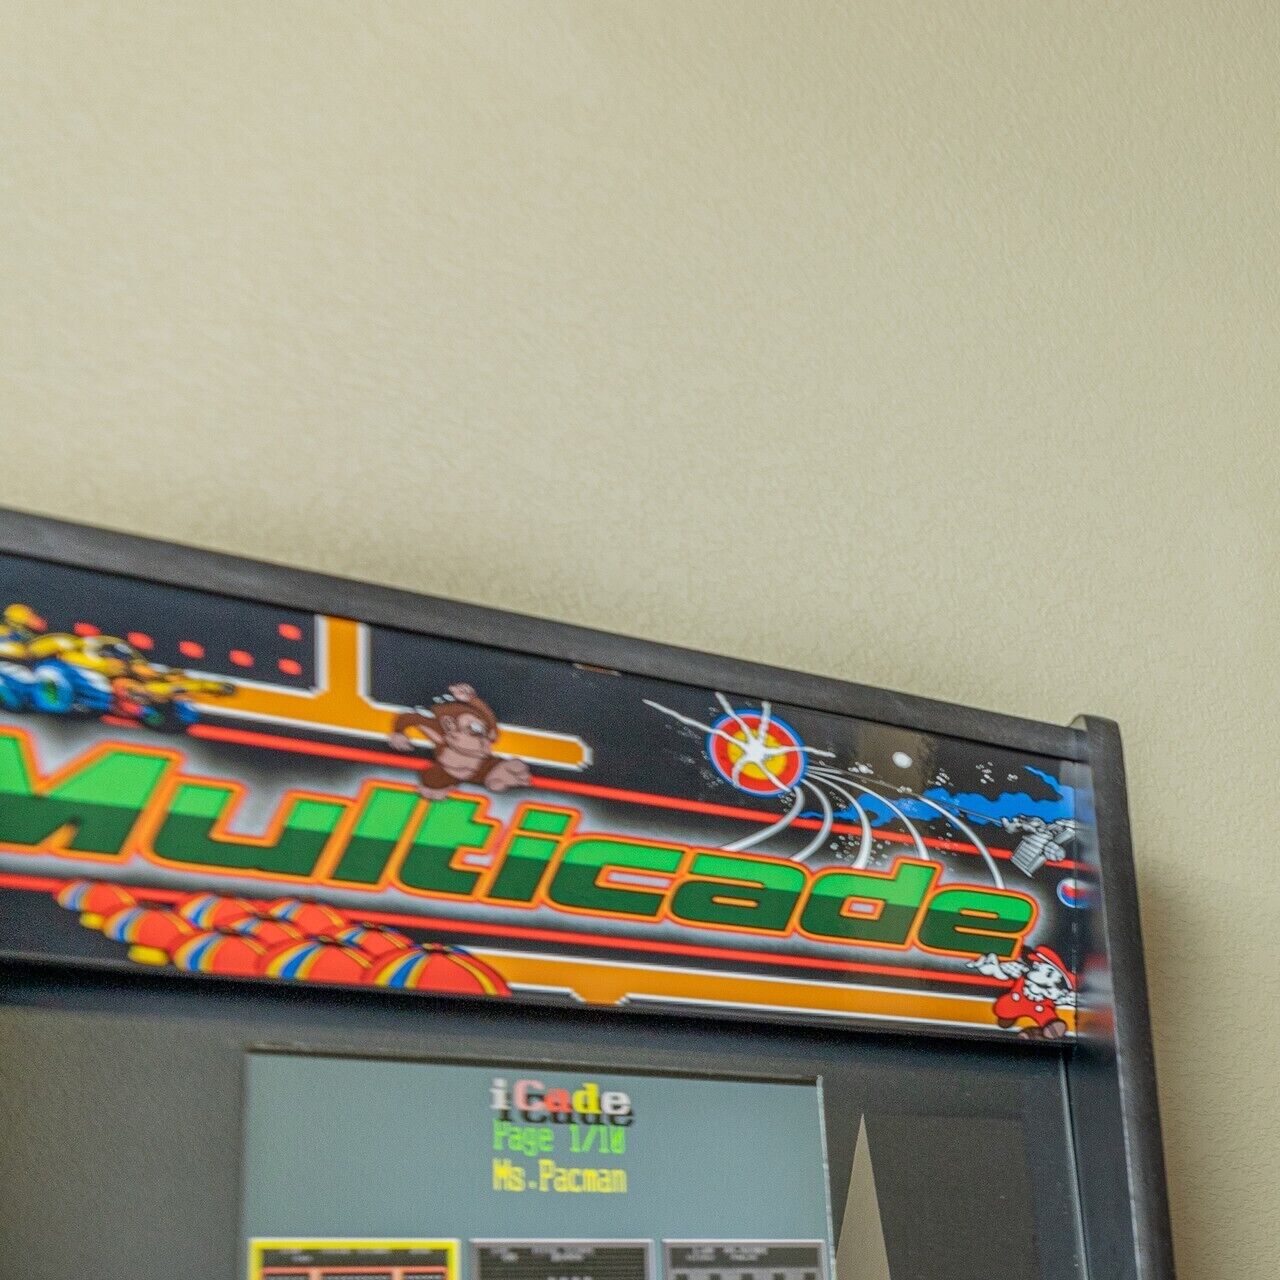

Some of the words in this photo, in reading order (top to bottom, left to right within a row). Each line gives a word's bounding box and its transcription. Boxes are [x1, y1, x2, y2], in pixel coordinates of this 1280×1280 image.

[0, 727, 1038, 960] Multicade
[489, 1077, 634, 1120] iCade
[492, 1119, 554, 1157] Page
[569, 1123, 626, 1154] 1/10
